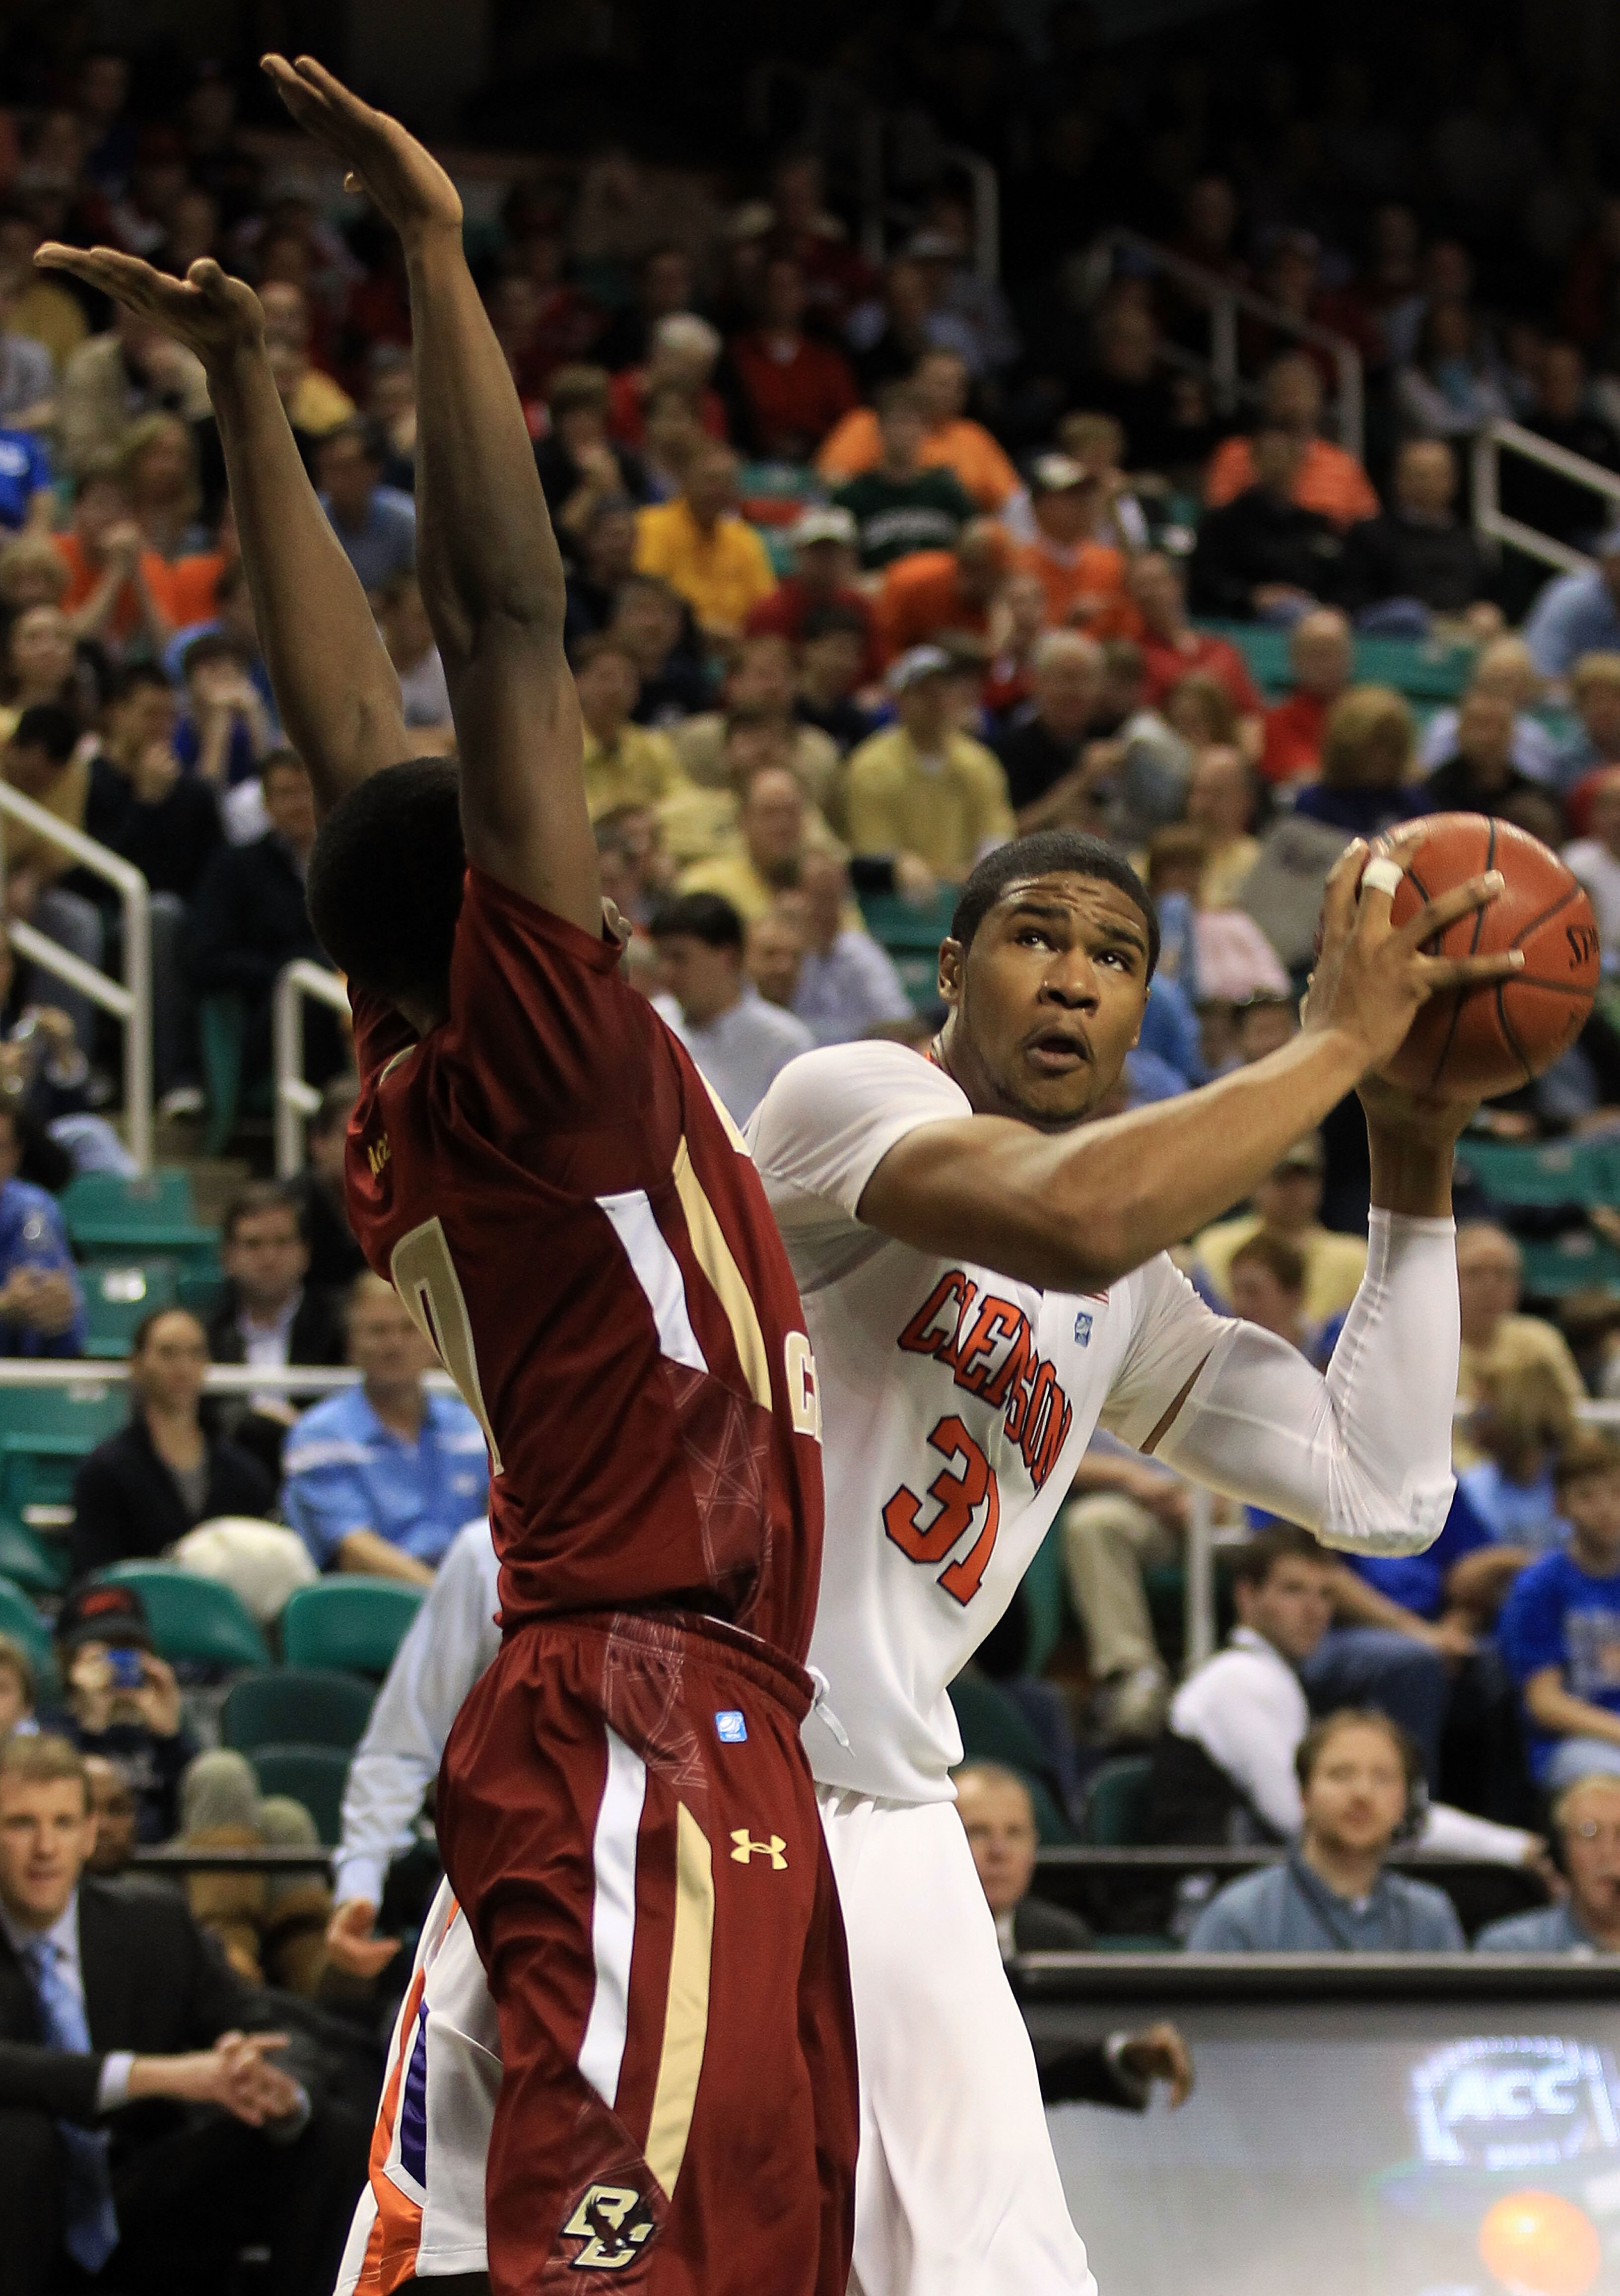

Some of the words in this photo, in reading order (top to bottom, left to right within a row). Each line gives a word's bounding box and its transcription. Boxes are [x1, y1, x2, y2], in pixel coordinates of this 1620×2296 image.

[897, 1269, 1073, 1492] CLEMSON
[881, 1414, 1000, 1607] 31
[1443, 2065, 1580, 2125] ACC
